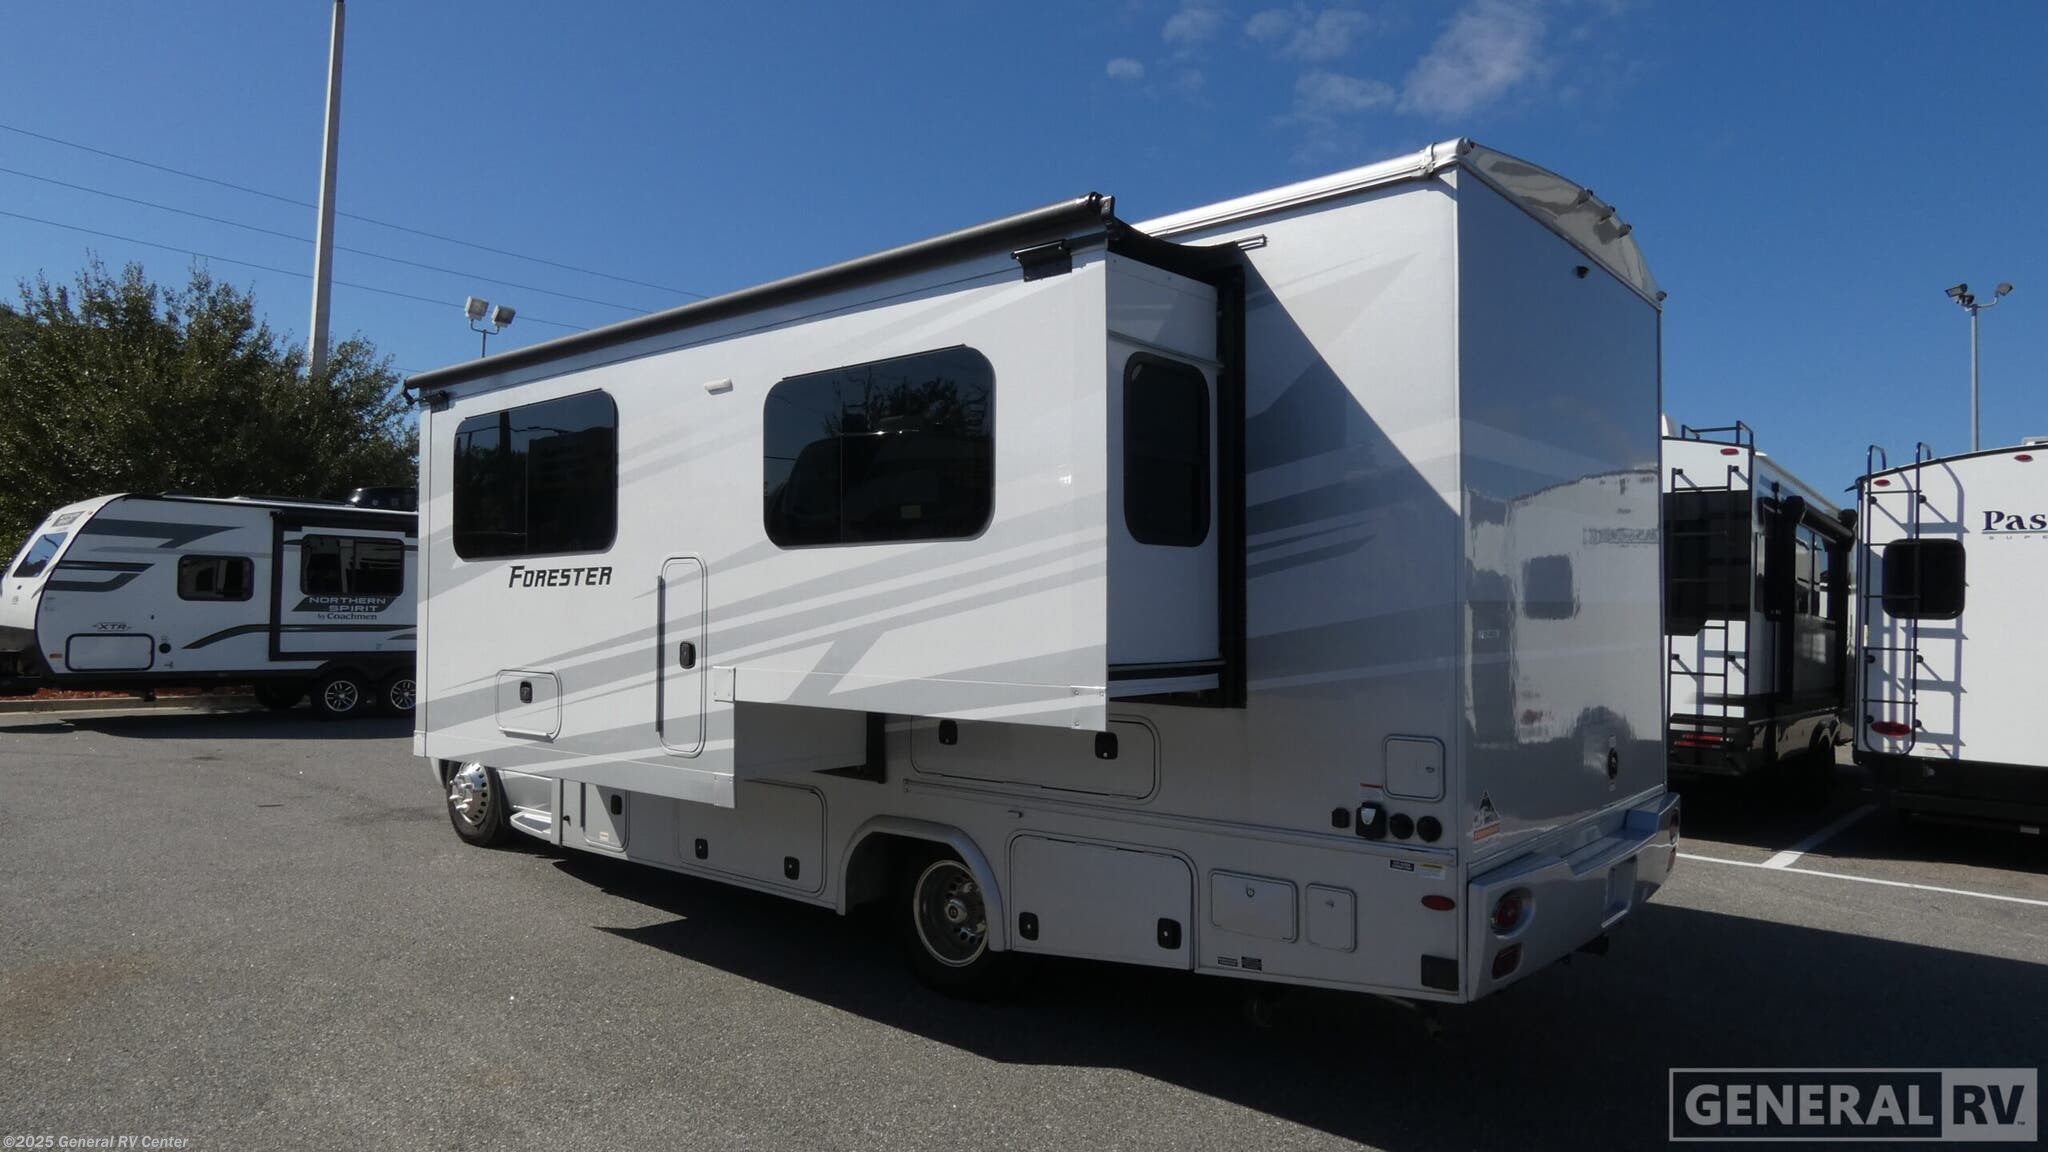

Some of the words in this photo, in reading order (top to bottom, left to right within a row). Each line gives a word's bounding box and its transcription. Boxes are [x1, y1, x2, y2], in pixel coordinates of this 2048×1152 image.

[508, 565, 612, 588] FORESTER
[308, 596, 387, 605] NORTHERN
[328, 605, 378, 613] SPIRIT
[327, 612, 377, 620] Coachmen
[99, 623, 128, 631] XTR
